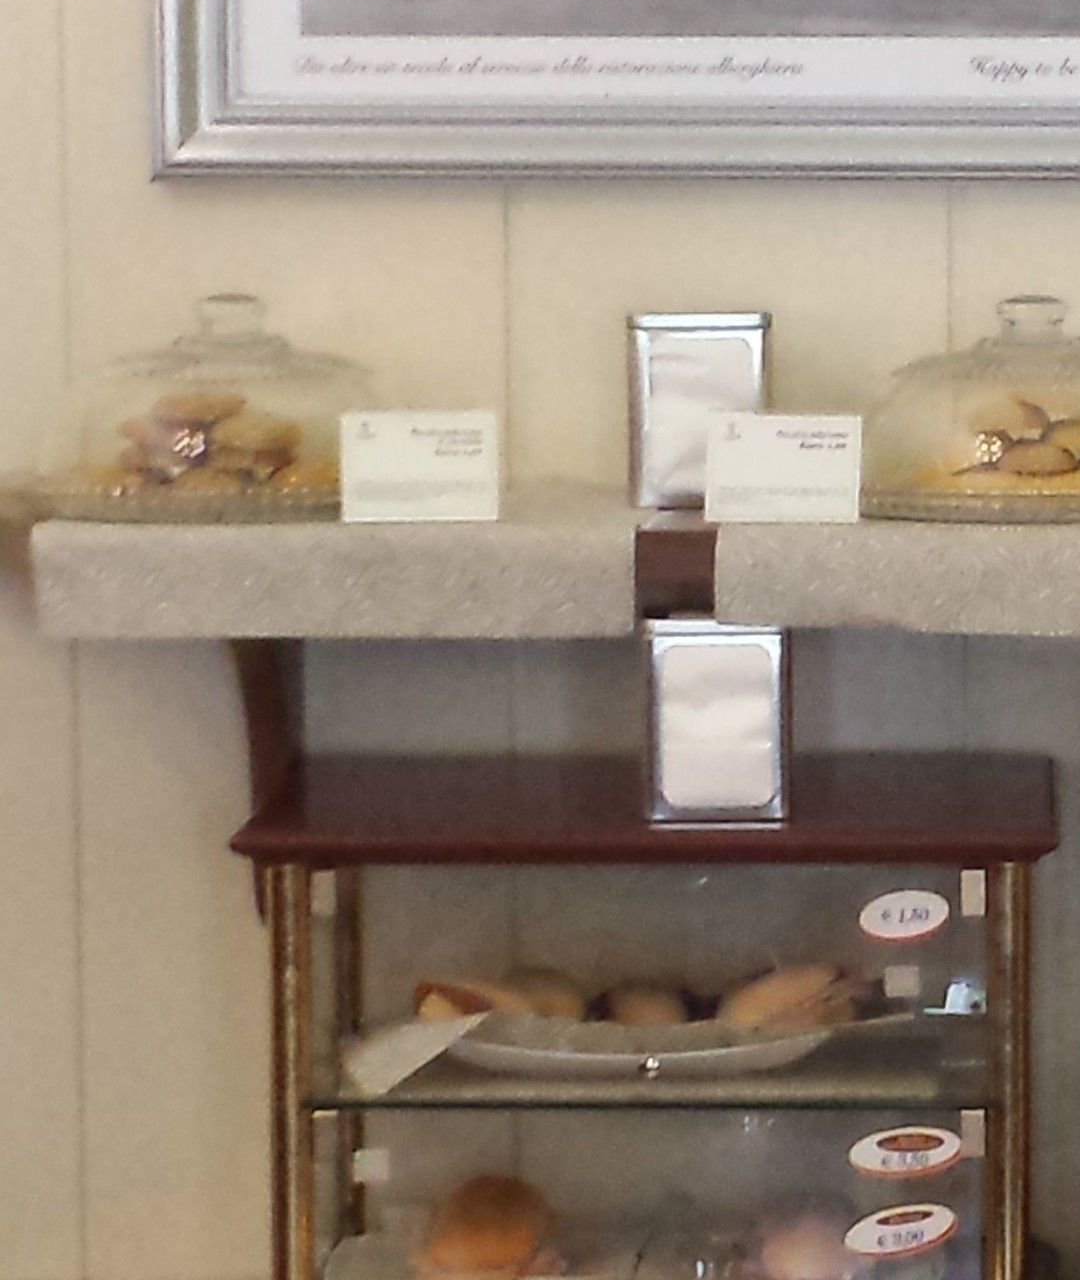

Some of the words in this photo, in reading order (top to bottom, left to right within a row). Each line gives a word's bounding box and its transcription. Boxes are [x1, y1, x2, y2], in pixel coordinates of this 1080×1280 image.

[970, 56, 1029, 81] Happy
[1034, 61, 1050, 74] to
[1059, 56, 1077, 75] be
